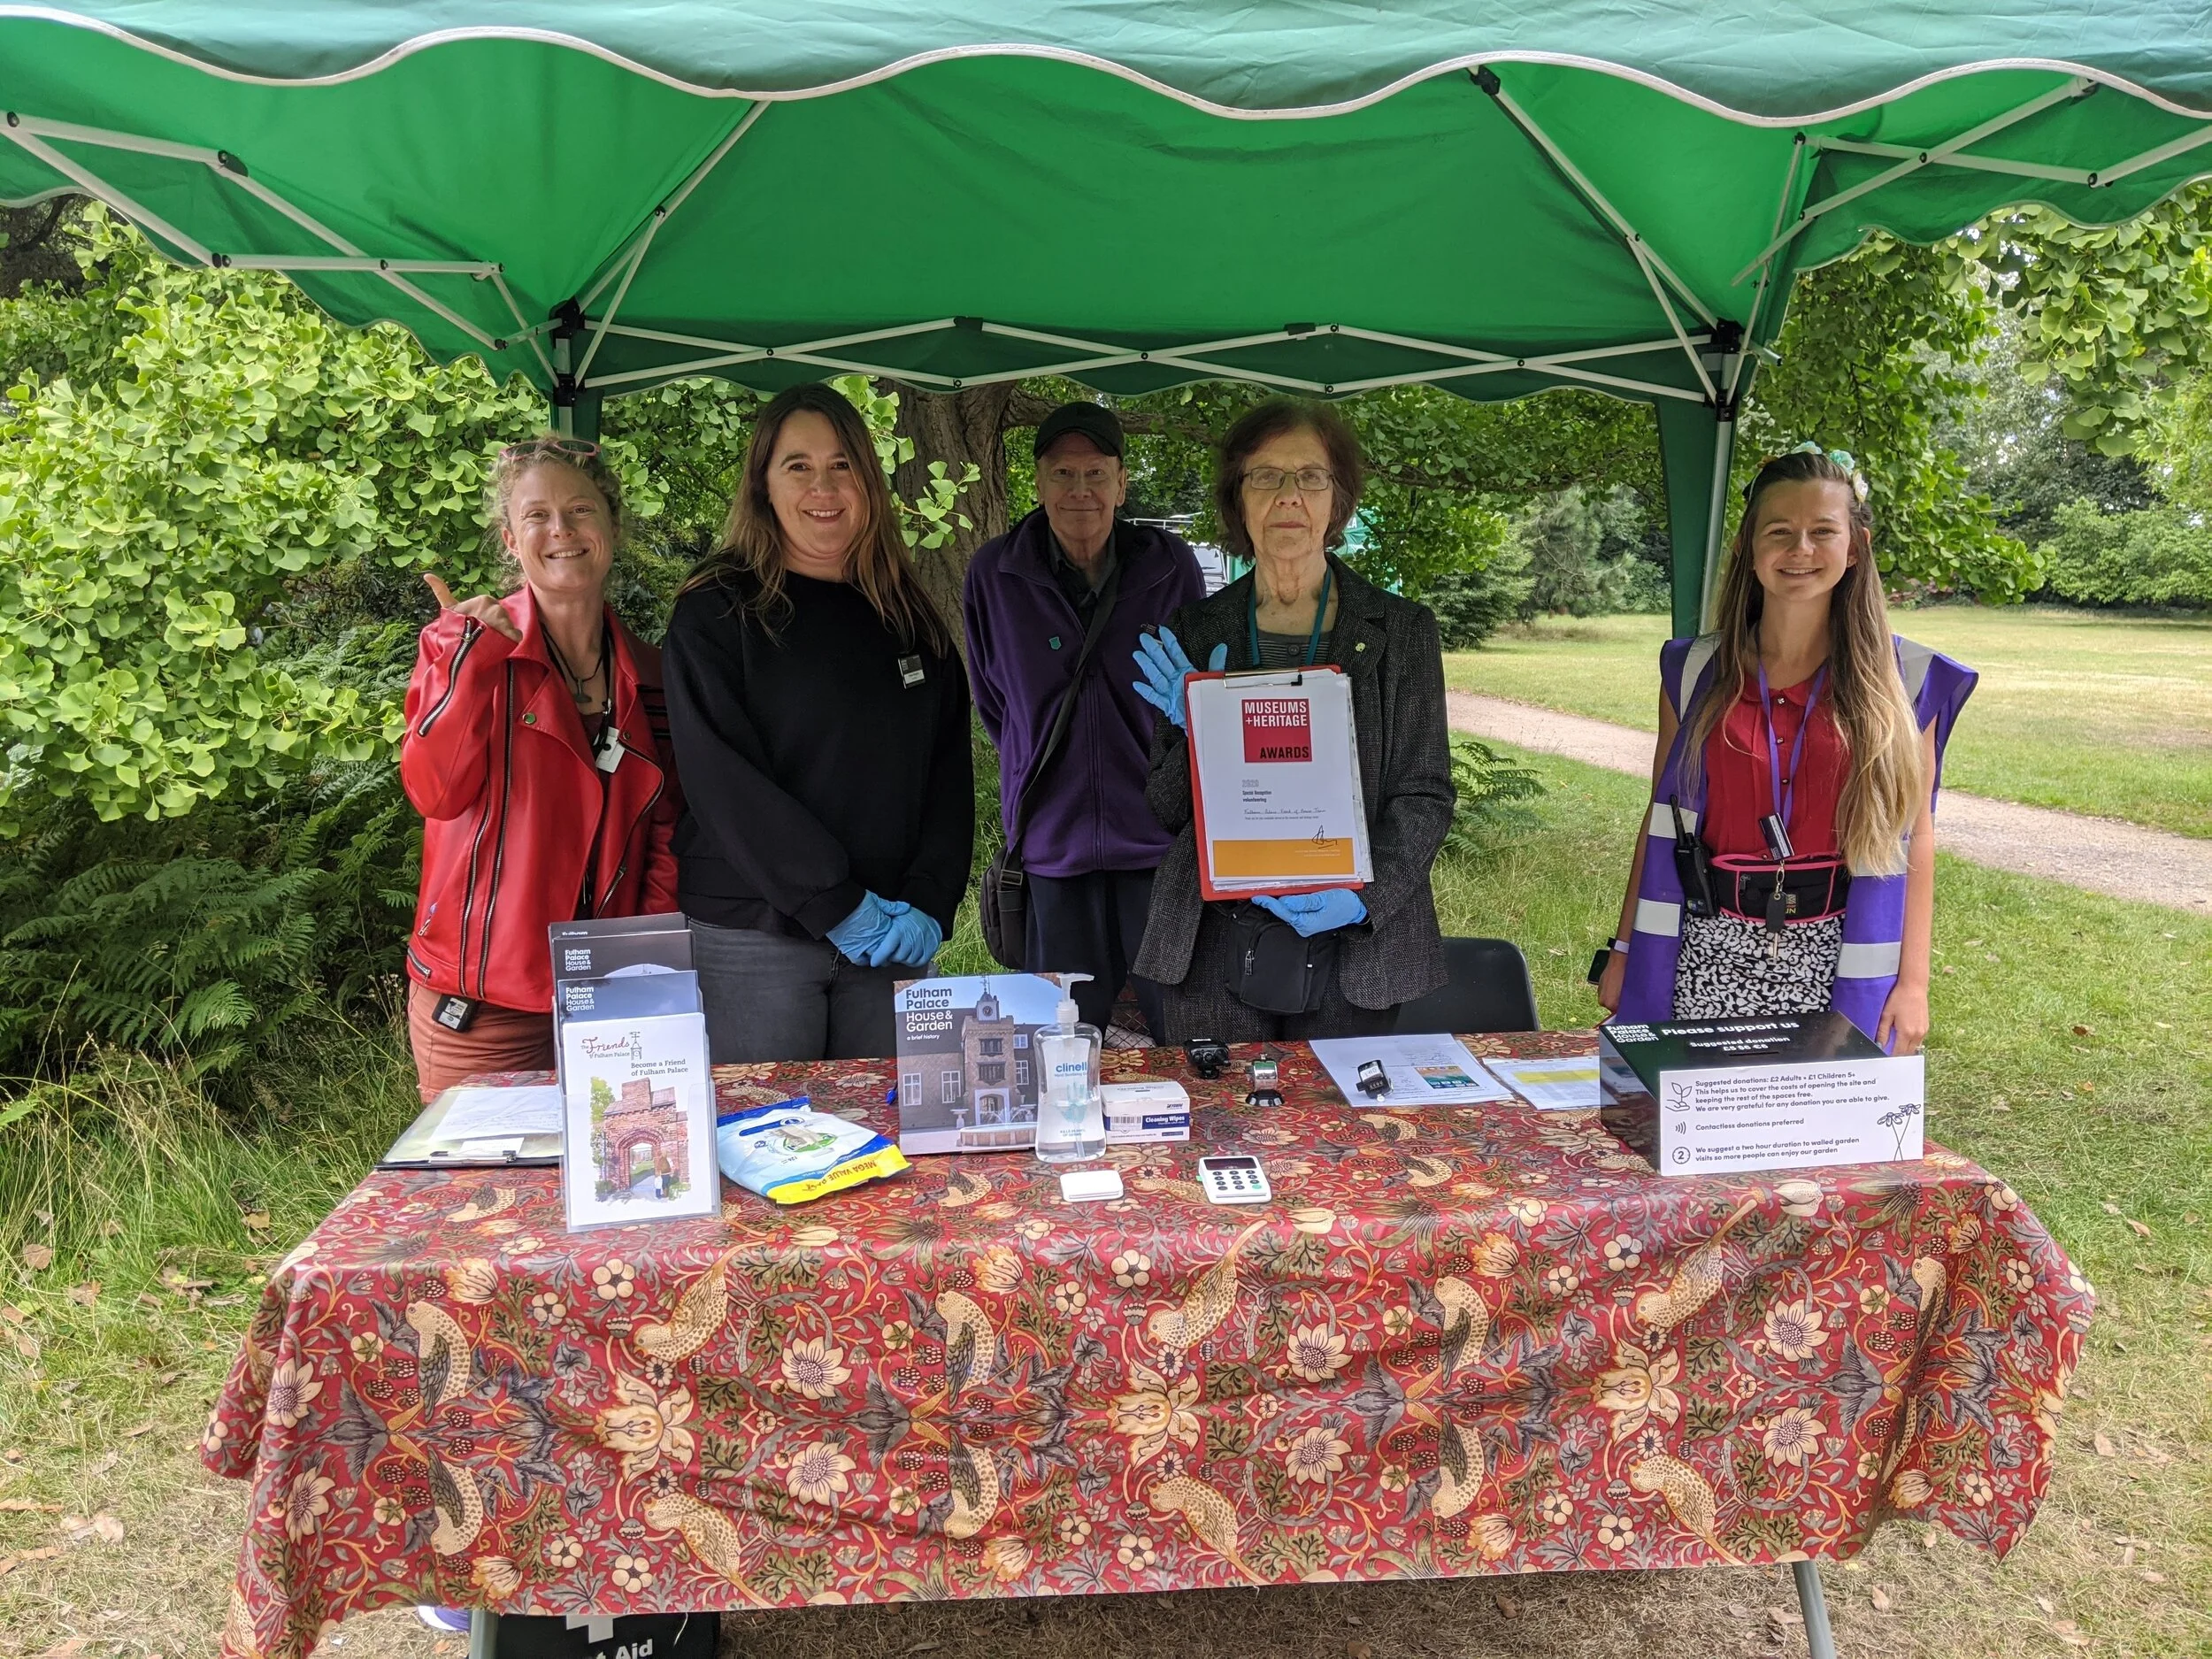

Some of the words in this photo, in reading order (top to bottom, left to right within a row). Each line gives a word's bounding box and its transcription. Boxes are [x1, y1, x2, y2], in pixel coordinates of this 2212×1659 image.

[1244, 701, 1307, 714] MUSEUMS
[1245, 715, 1308, 727] +HERITAGE
[1260, 746, 1310, 759] AWARDS
[905, 987, 953, 1000] Fulham
[906, 998, 949, 1010] Palace
[906, 1020, 953, 1033] Garden
[1662, 1027, 1715, 1036] Please
[1717, 1022, 1778, 1033] support
[581, 1037, 630, 1054] Friends
[1689, 1039, 1744, 1048] Suggested
[1056, 1061, 1087, 1072] clinell
[1695, 1079, 1732, 1087] Suggested
[1736, 1102, 1764, 1111] grateful
[1145, 1116, 1169, 1125] Cleaning
[1169, 1115, 1185, 1124] Wipes
[1771, 1118, 1804, 1127] preferred
[1678, 1150, 1685, 1160] 2
[1742, 1151, 1766, 1160] people
[1813, 1147, 1838, 1156] garden
[852, 1160, 878, 1173] MEGA
[827, 1168, 853, 1181] VALUE
[615, 1638, 653, 1659] Aid
